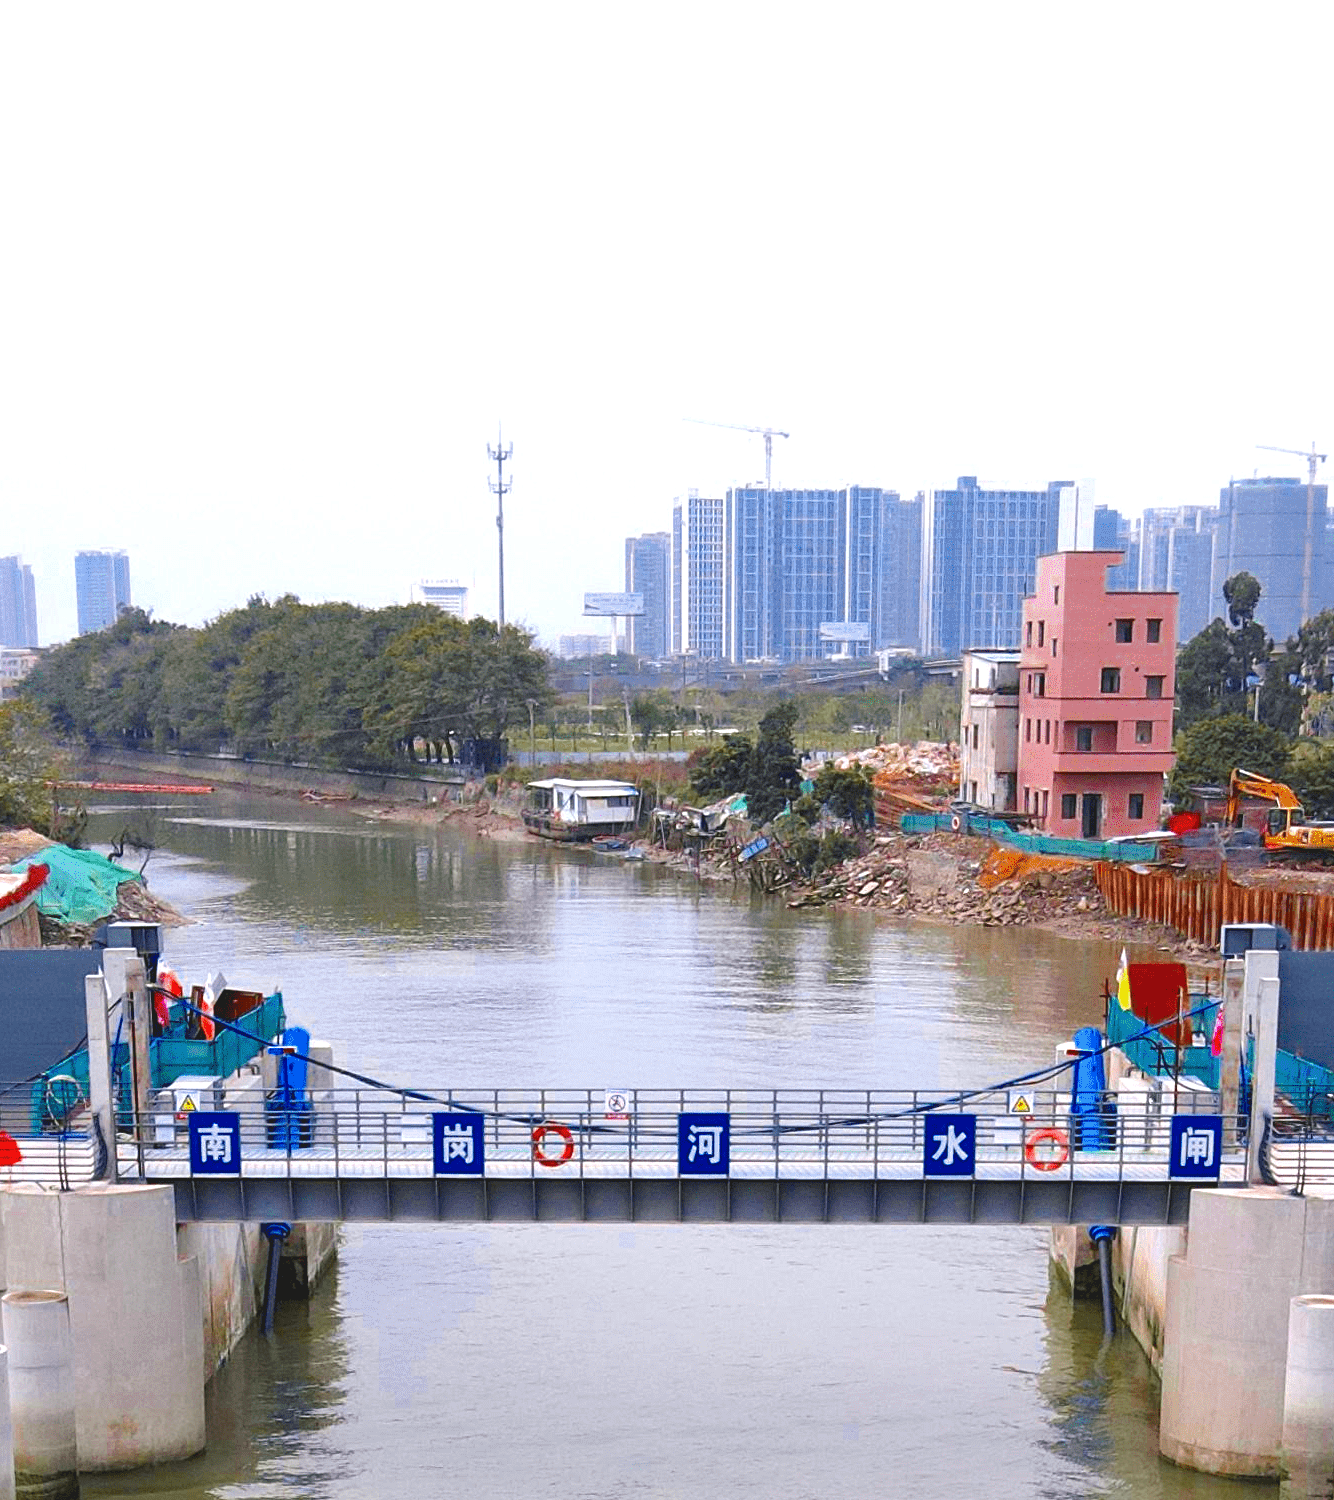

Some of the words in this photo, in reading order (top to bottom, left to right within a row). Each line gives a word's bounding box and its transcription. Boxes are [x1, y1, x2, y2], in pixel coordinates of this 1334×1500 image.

[198, 1123, 233, 1163] 南
[443, 1123, 473, 1164] 岗
[688, 1126, 723, 1163] 河
[932, 1126, 968, 1165] 水
[1180, 1127, 1214, 1167] 闸
